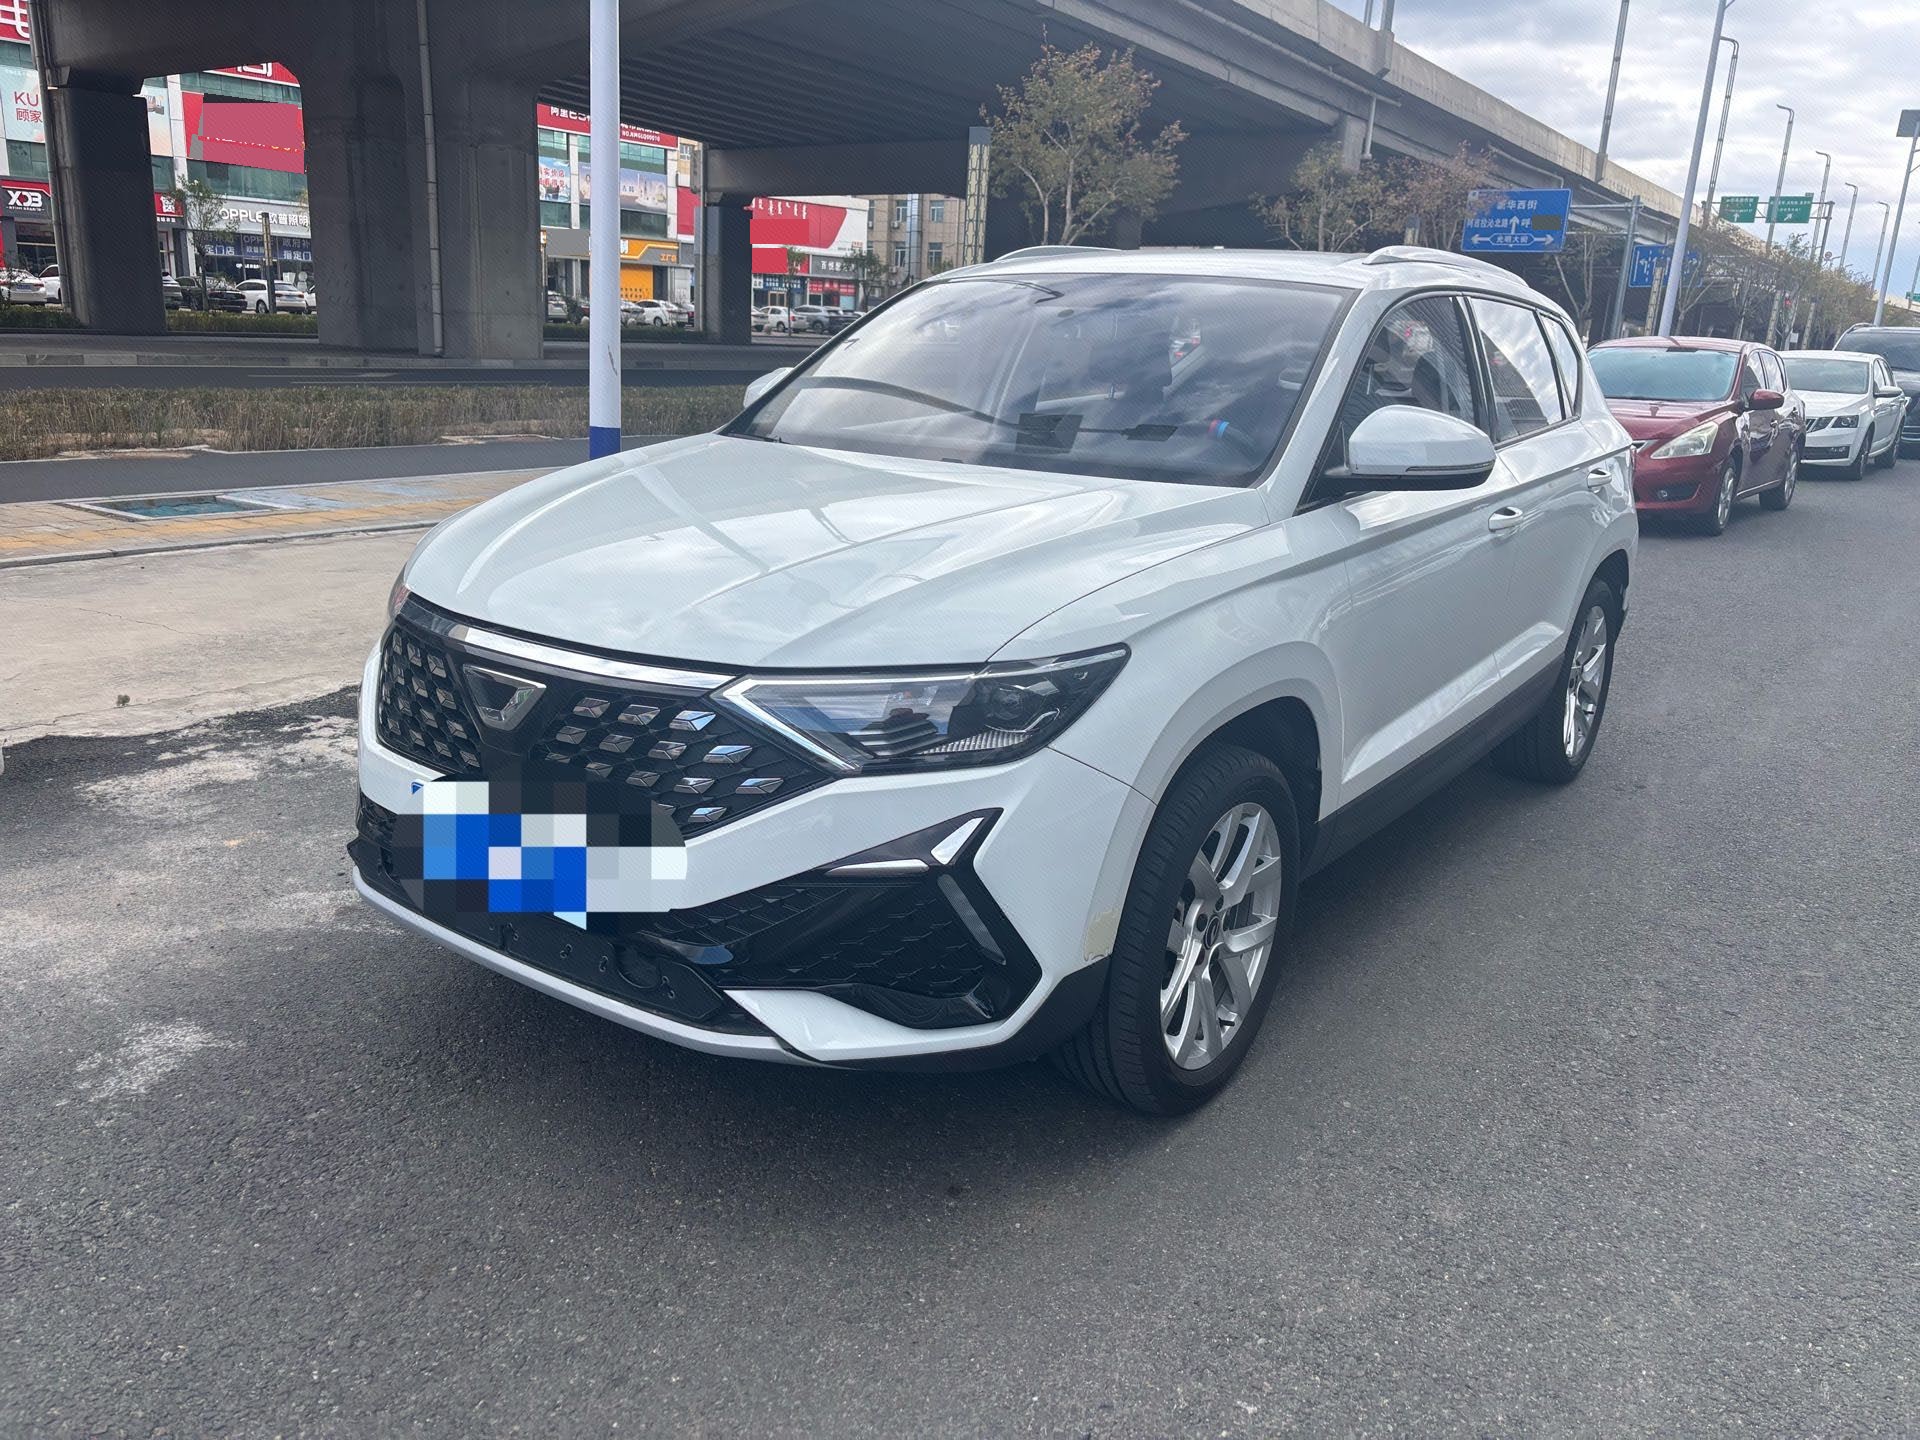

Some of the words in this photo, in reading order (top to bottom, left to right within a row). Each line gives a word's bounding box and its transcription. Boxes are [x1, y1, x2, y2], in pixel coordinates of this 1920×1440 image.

[16, 108, 43, 123] 顾家
[219, 208, 262, 222] OPPLE
[268, 212, 309, 227] 欧普照明
